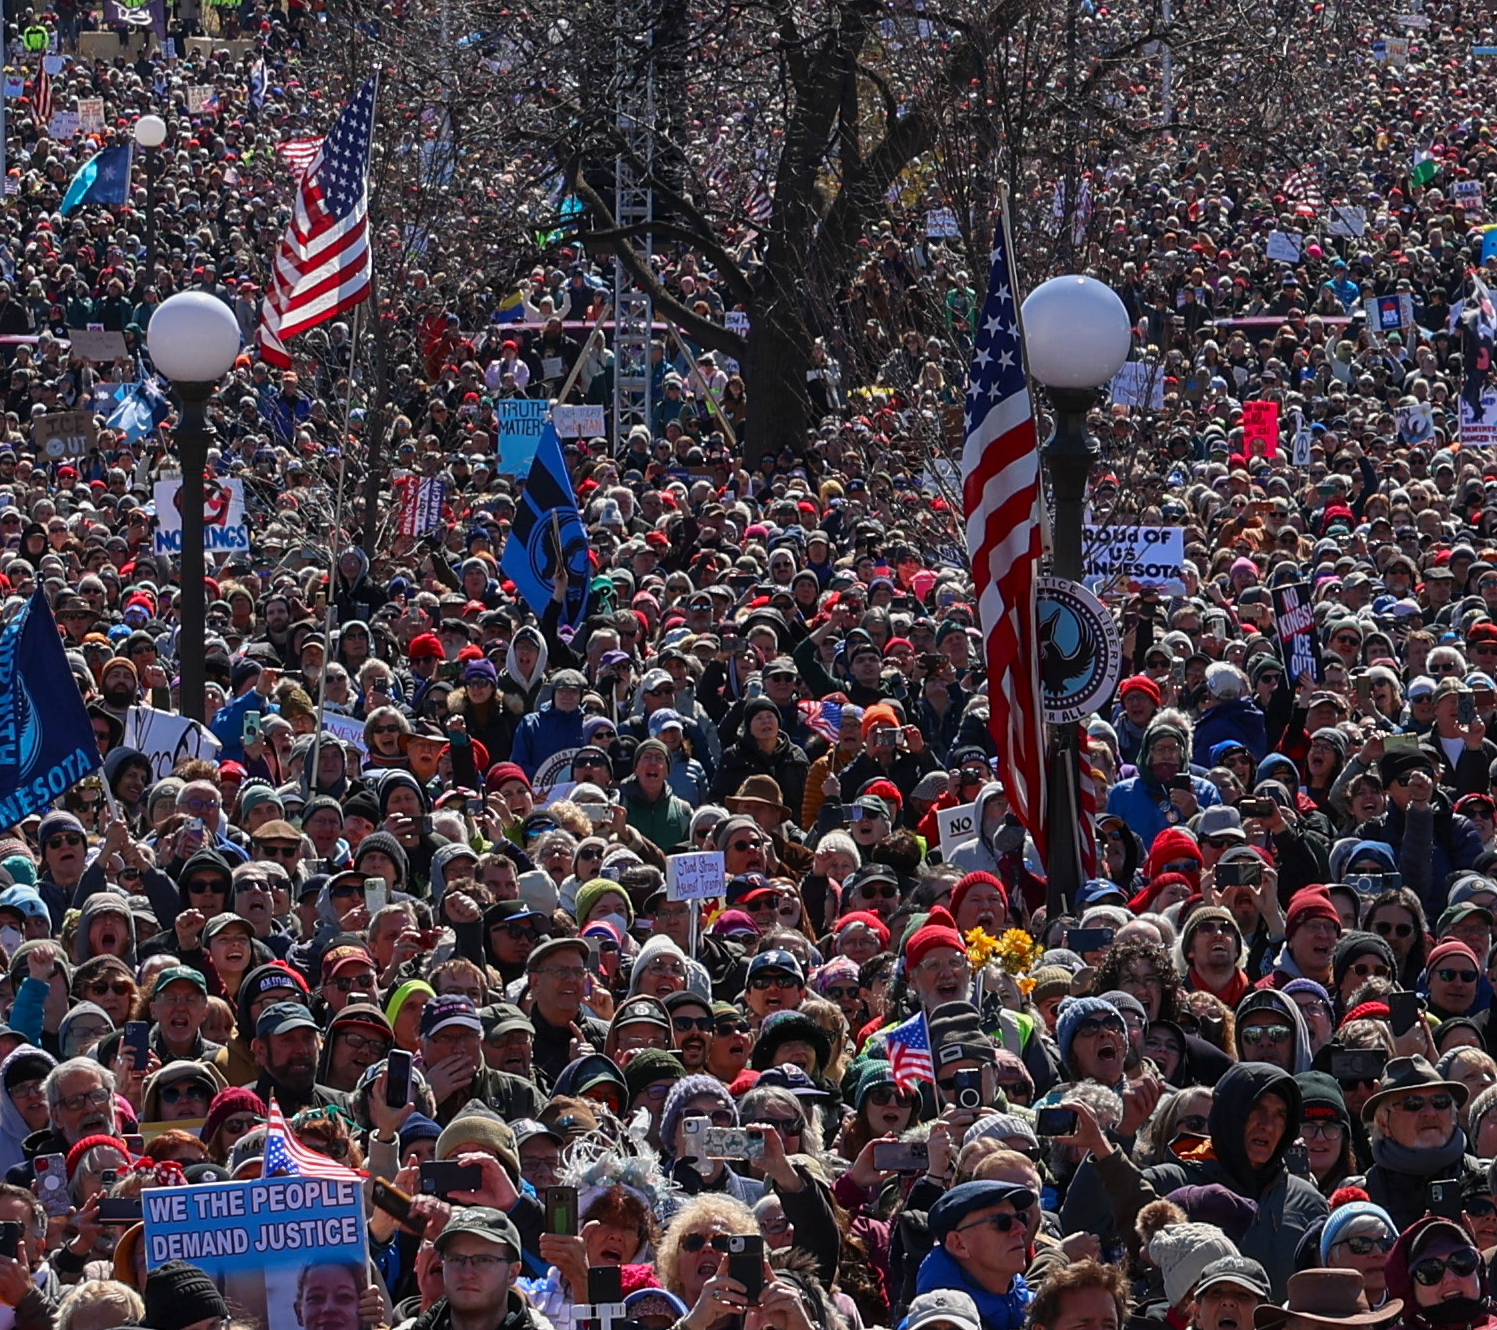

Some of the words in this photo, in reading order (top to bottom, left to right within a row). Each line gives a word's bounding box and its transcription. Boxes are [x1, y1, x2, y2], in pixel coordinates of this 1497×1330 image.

[500, 400, 548, 418] TRUTH
[45, 416, 84, 434] ICE
[499, 419, 548, 437] MATTERS
[155, 531, 181, 551] NO
[202, 526, 247, 549] INGS
[1144, 530, 1171, 545] OF
[1108, 547, 1136, 561] US
[1083, 563, 1183, 579] INNESOTA
[1283, 589, 1298, 608] NO
[1279, 606, 1315, 638] KINGS!
[1096, 610, 1119, 686] LIBERTY
[1292, 633, 1310, 655] ICE
[1290, 652, 1316, 683] OUT!
[1060, 705, 1085, 722] ALL
[948, 815, 972, 835] NO
[676, 858, 698, 877] Stand
[698, 856, 718, 874] Strong
[675, 877, 697, 895] Against
[148, 1194, 187, 1219] WE
[191, 1188, 245, 1216] THE
[250, 1179, 355, 1213] PEOPLE
[153, 1229, 248, 1261] DEMAND
[255, 1217, 358, 1249] JUSTICE
